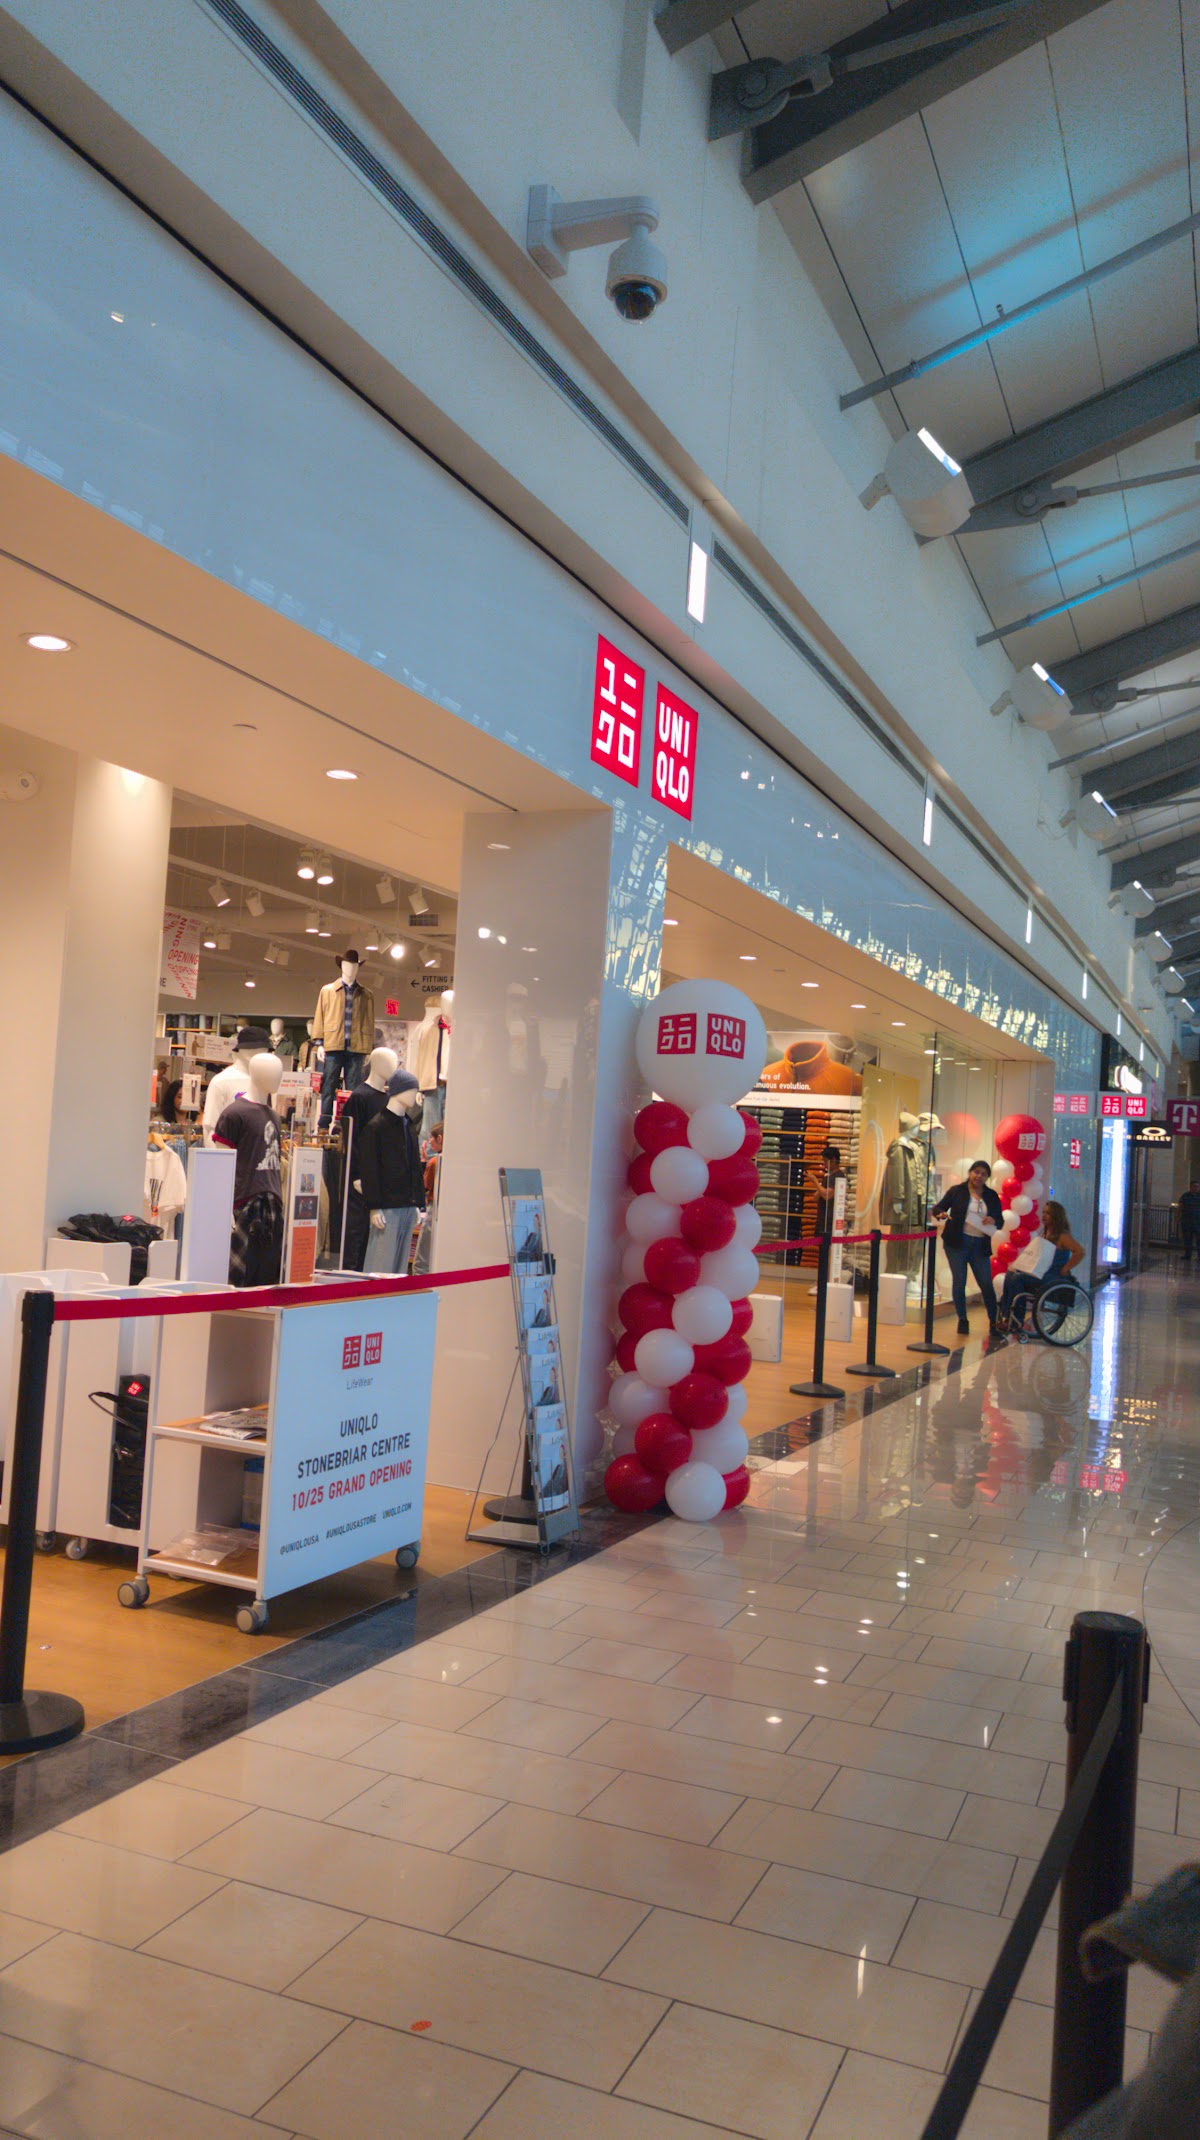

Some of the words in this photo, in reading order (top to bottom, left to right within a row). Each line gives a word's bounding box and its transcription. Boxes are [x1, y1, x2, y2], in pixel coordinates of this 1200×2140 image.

[659, 702, 690, 758] UNI
[656, 750, 690, 803] QLO
[168, 948, 199, 965] OPENING
[422, 975, 448, 983] FITTING
[711, 1017, 740, 1036] UNI
[710, 1033, 741, 1053] QLO
[779, 1083, 811, 1091] evolution.
[1127, 1106, 1144, 1115] QLO
[1136, 1134, 1171, 1142] OAKLEY
[366, 1336, 380, 1349] UNI
[366, 1349, 380, 1363] QLO
[340, 1413, 379, 1438] UNIQLO
[297, 1444, 367, 1479] STONEBRIAR
[371, 1432, 411, 1458] CENTRE
[292, 1485, 325, 1512] 10/25
[328, 1473, 366, 1500] GRAND
[369, 1459, 412, 1487] OPENING
[280, 1534, 319, 1555] @UNIQLOUSA
[325, 1514, 377, 1539] #UNIQLOUSASTORE
[382, 1502, 412, 1520] UNIQLO.COM
